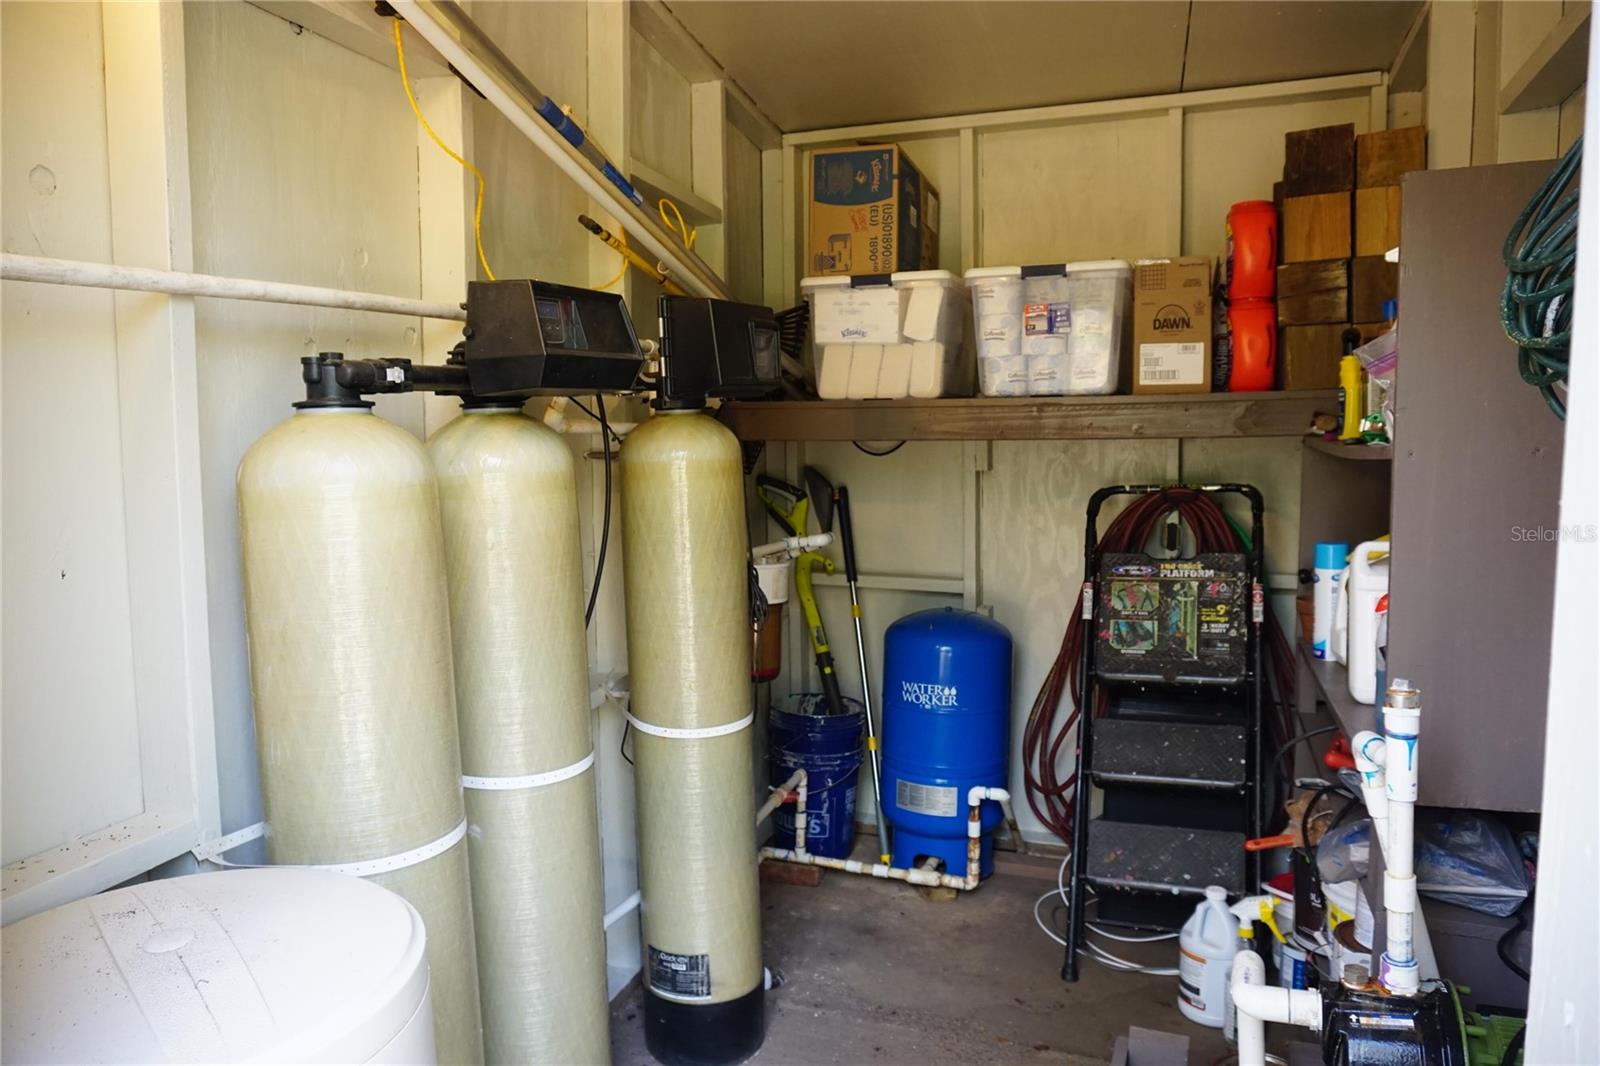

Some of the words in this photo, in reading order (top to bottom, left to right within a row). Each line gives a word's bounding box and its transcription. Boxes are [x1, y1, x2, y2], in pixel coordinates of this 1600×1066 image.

[869, 205, 880, 226] (EU)
[1153, 317, 1191, 330] DAWN
[1160, 569, 1215, 577] PLATFORM
[902, 681, 943, 695] WATER
[902, 691, 958, 706] WORKER
